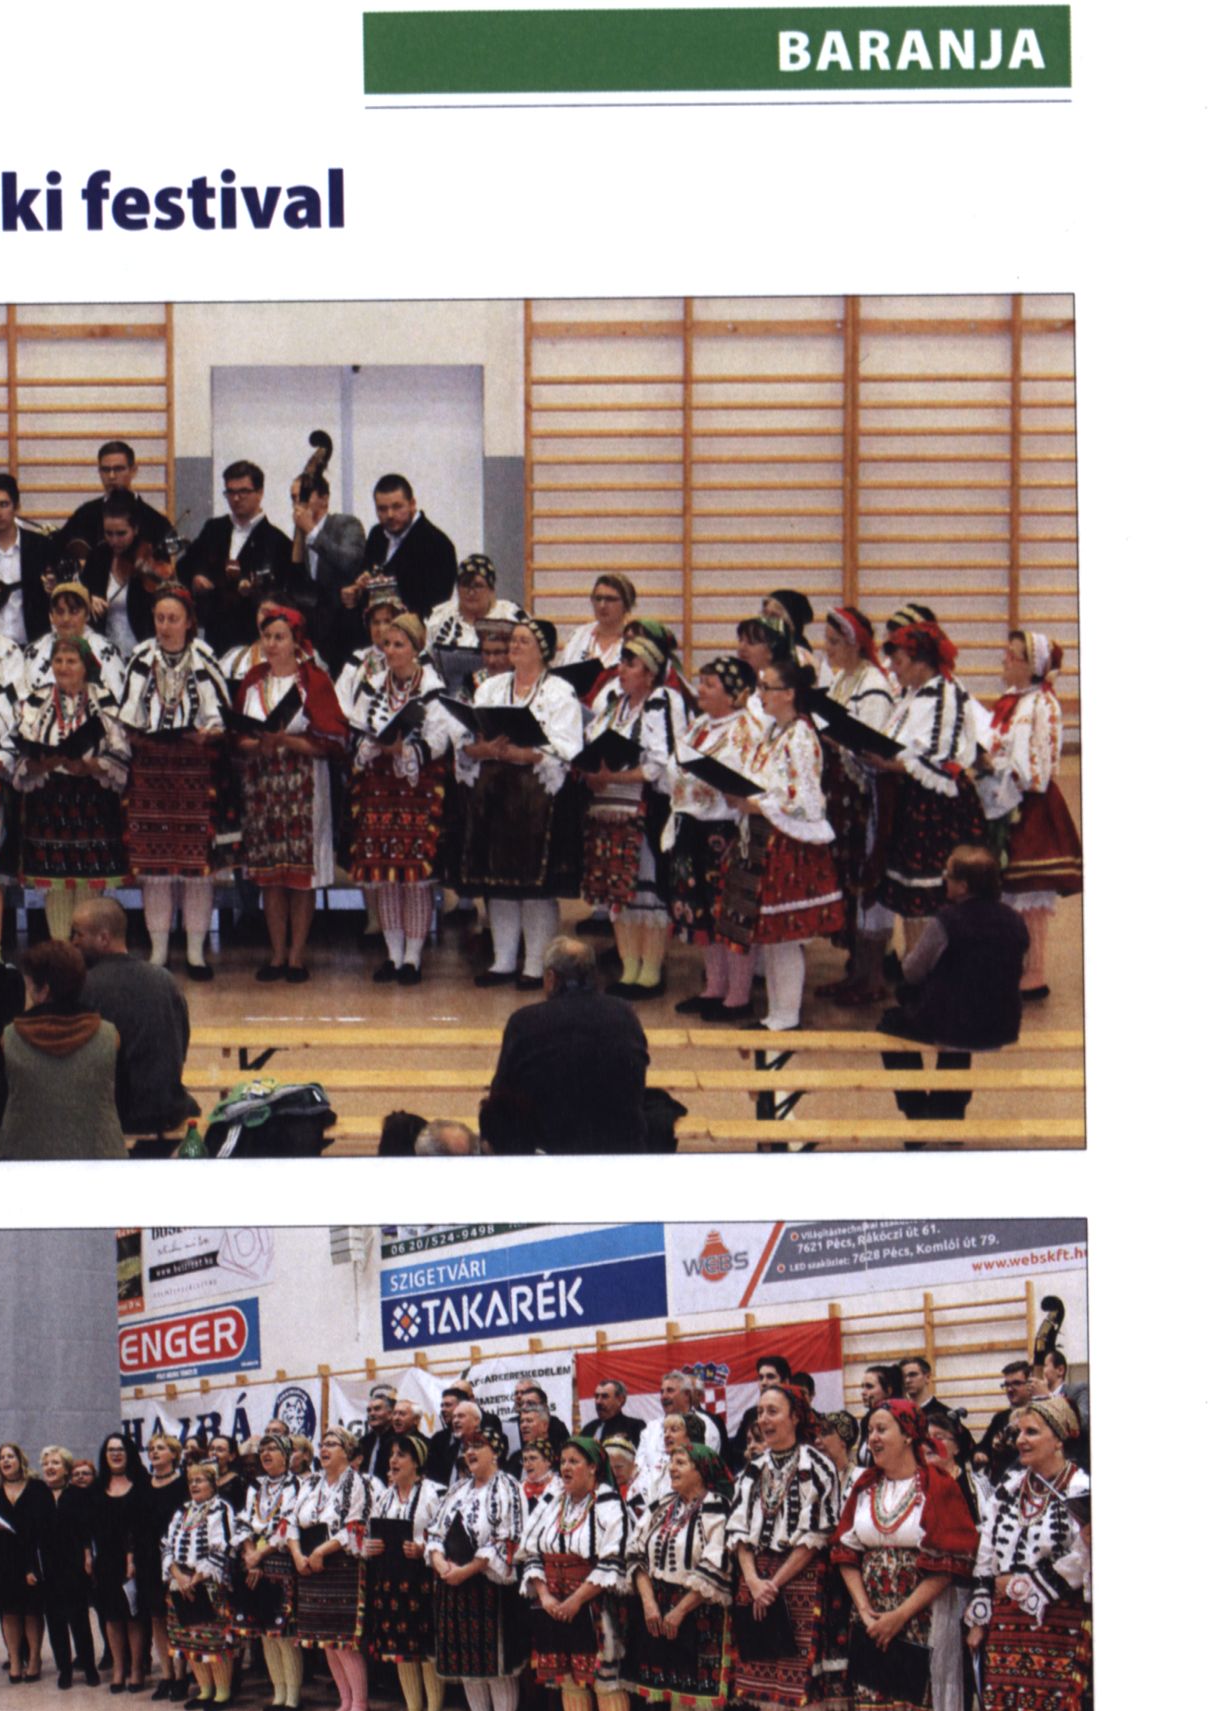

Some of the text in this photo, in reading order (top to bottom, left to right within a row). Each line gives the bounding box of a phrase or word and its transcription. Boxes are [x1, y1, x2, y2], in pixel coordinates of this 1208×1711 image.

[777, 28, 1047, 72] BARANJA
[81, 168, 345, 231] festival
[390, 1258, 487, 1293] SZIGETVÁRI
[421, 1269, 585, 1337] TAKARÉK
